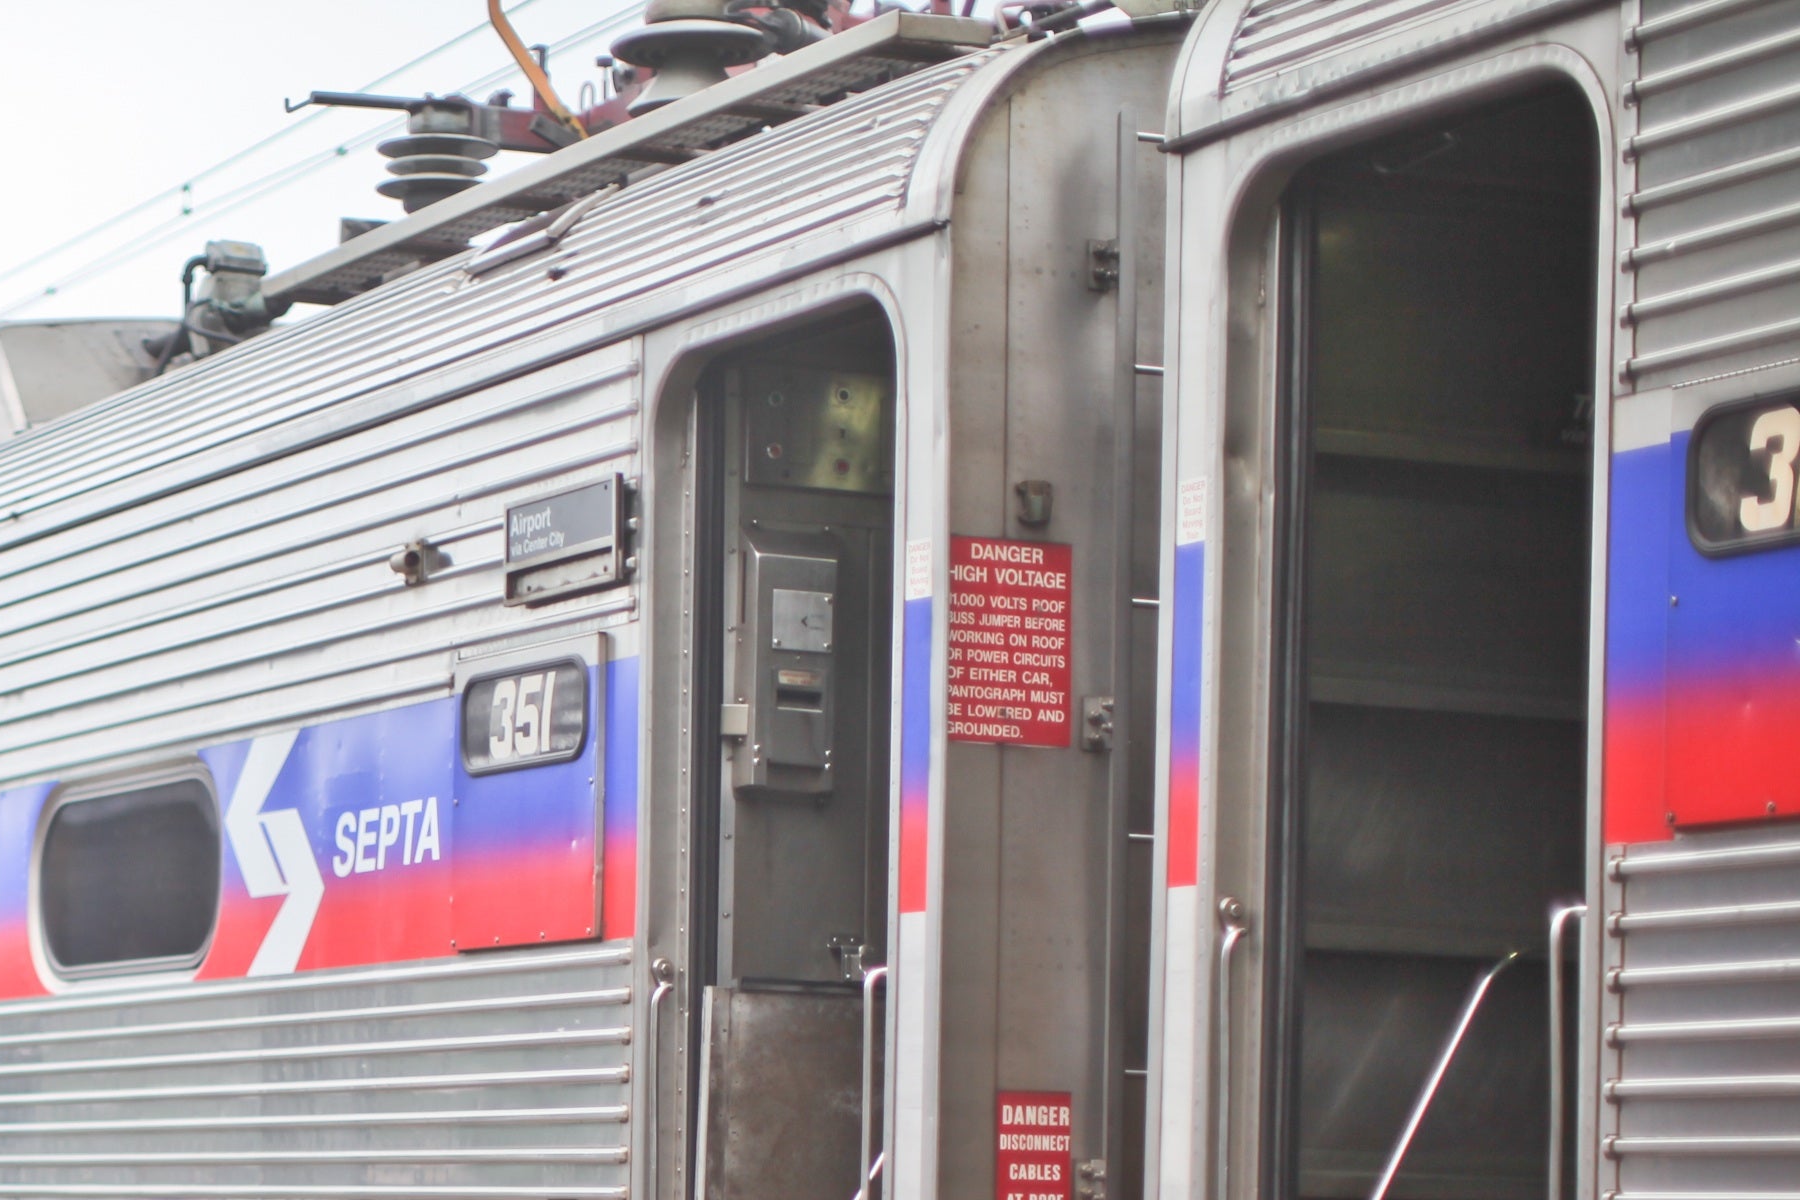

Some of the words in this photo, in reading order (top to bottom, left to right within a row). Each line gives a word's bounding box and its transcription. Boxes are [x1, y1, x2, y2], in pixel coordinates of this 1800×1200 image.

[511, 507, 551, 537] Airport
[511, 541, 522, 557] via
[523, 536, 548, 554] Center
[549, 531, 565, 547] City
[971, 543, 1044, 564] DANGER
[995, 567, 1066, 589] VOLTAGE
[990, 596, 1027, 610] VOLTS
[979, 614, 1021, 628] JUMPER
[1025, 617, 1065, 632] BEFORE
[949, 629, 1004, 645] WORKING
[1009, 634, 1026, 646] ON
[1032, 636, 1065, 649] ROOF
[967, 650, 1008, 664] POWER
[1013, 653, 1065, 668] CIRCUITS
[970, 668, 1016, 682] EITHER
[1022, 672, 1053, 687] CAR,
[948, 685, 1025, 701] PANTOGRAPH
[1030, 691, 1064, 704] MUST
[489, 671, 557, 760] 351
[968, 705, 1032, 720] LOWERED
[1037, 710, 1064, 722] AND
[948, 721, 1023, 738] GROUNDED.
[332, 797, 440, 878] SEPTA
[1002, 1105, 1070, 1126] DANGER
[1000, 1134, 1070, 1151] DISCONNECT
[1009, 1164, 1061, 1181] CABLES
